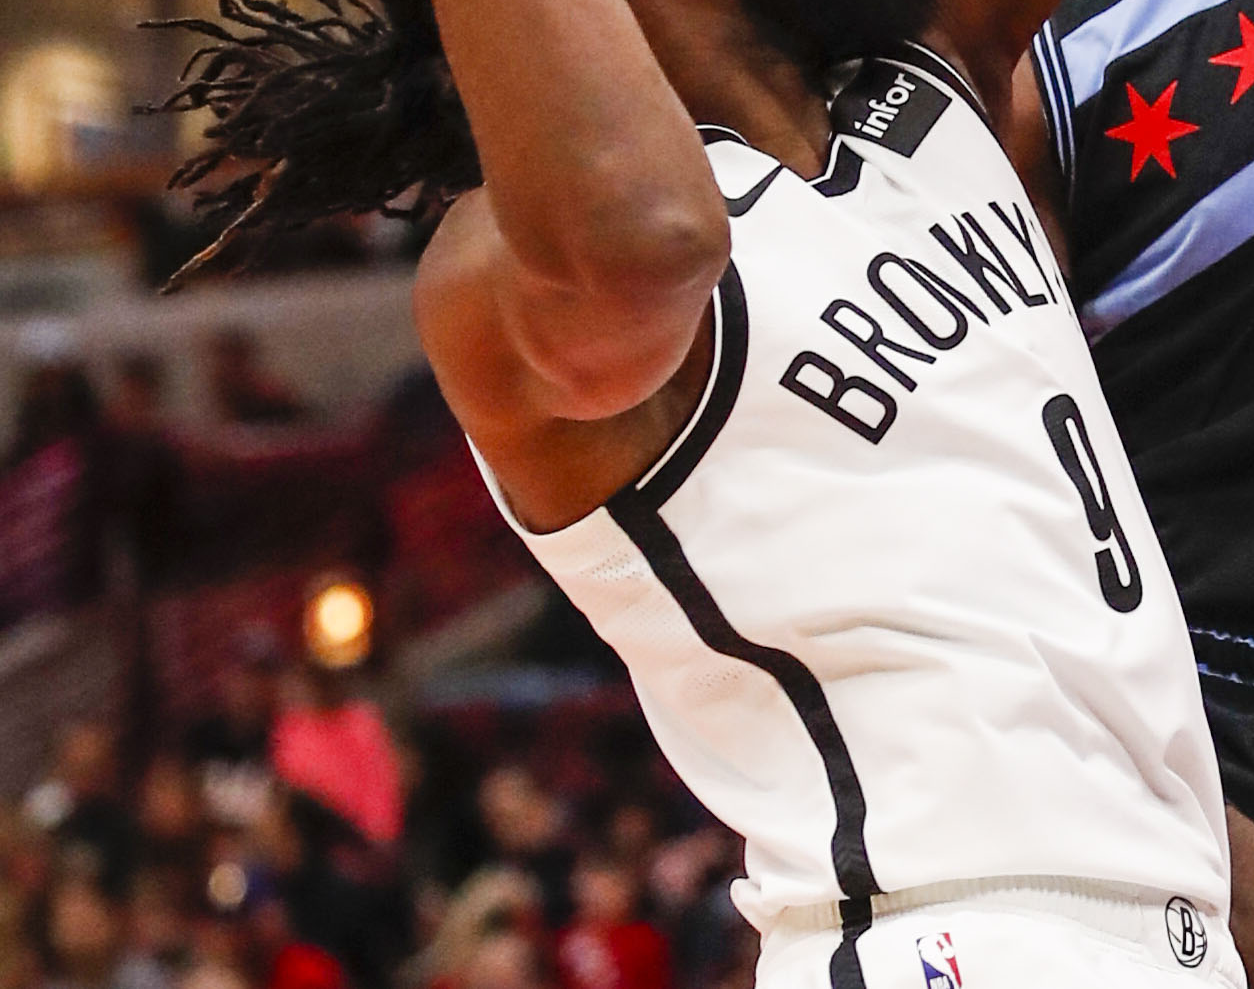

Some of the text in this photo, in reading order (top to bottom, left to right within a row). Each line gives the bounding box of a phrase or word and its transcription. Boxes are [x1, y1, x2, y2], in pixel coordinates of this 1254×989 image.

[854, 72, 916, 139] infor
[779, 200, 1073, 446] BROKLY
[1042, 393, 1143, 614] 9
